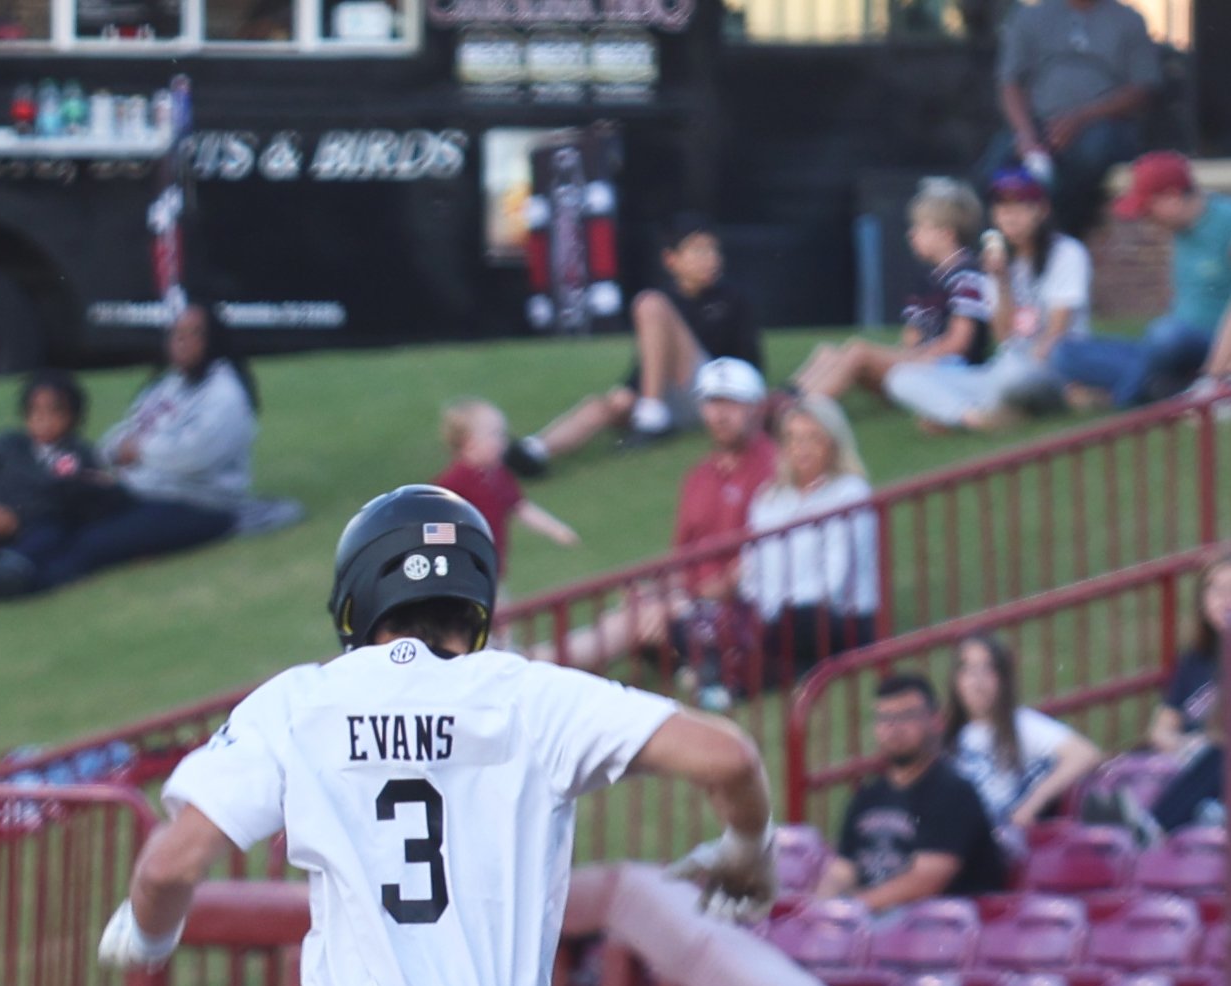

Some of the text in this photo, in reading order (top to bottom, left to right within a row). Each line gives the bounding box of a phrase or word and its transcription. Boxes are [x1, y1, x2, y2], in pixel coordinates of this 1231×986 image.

[313, 129, 468, 181] BIRDS
[347, 715, 455, 761] EVANS
[375, 778, 449, 924] 3
